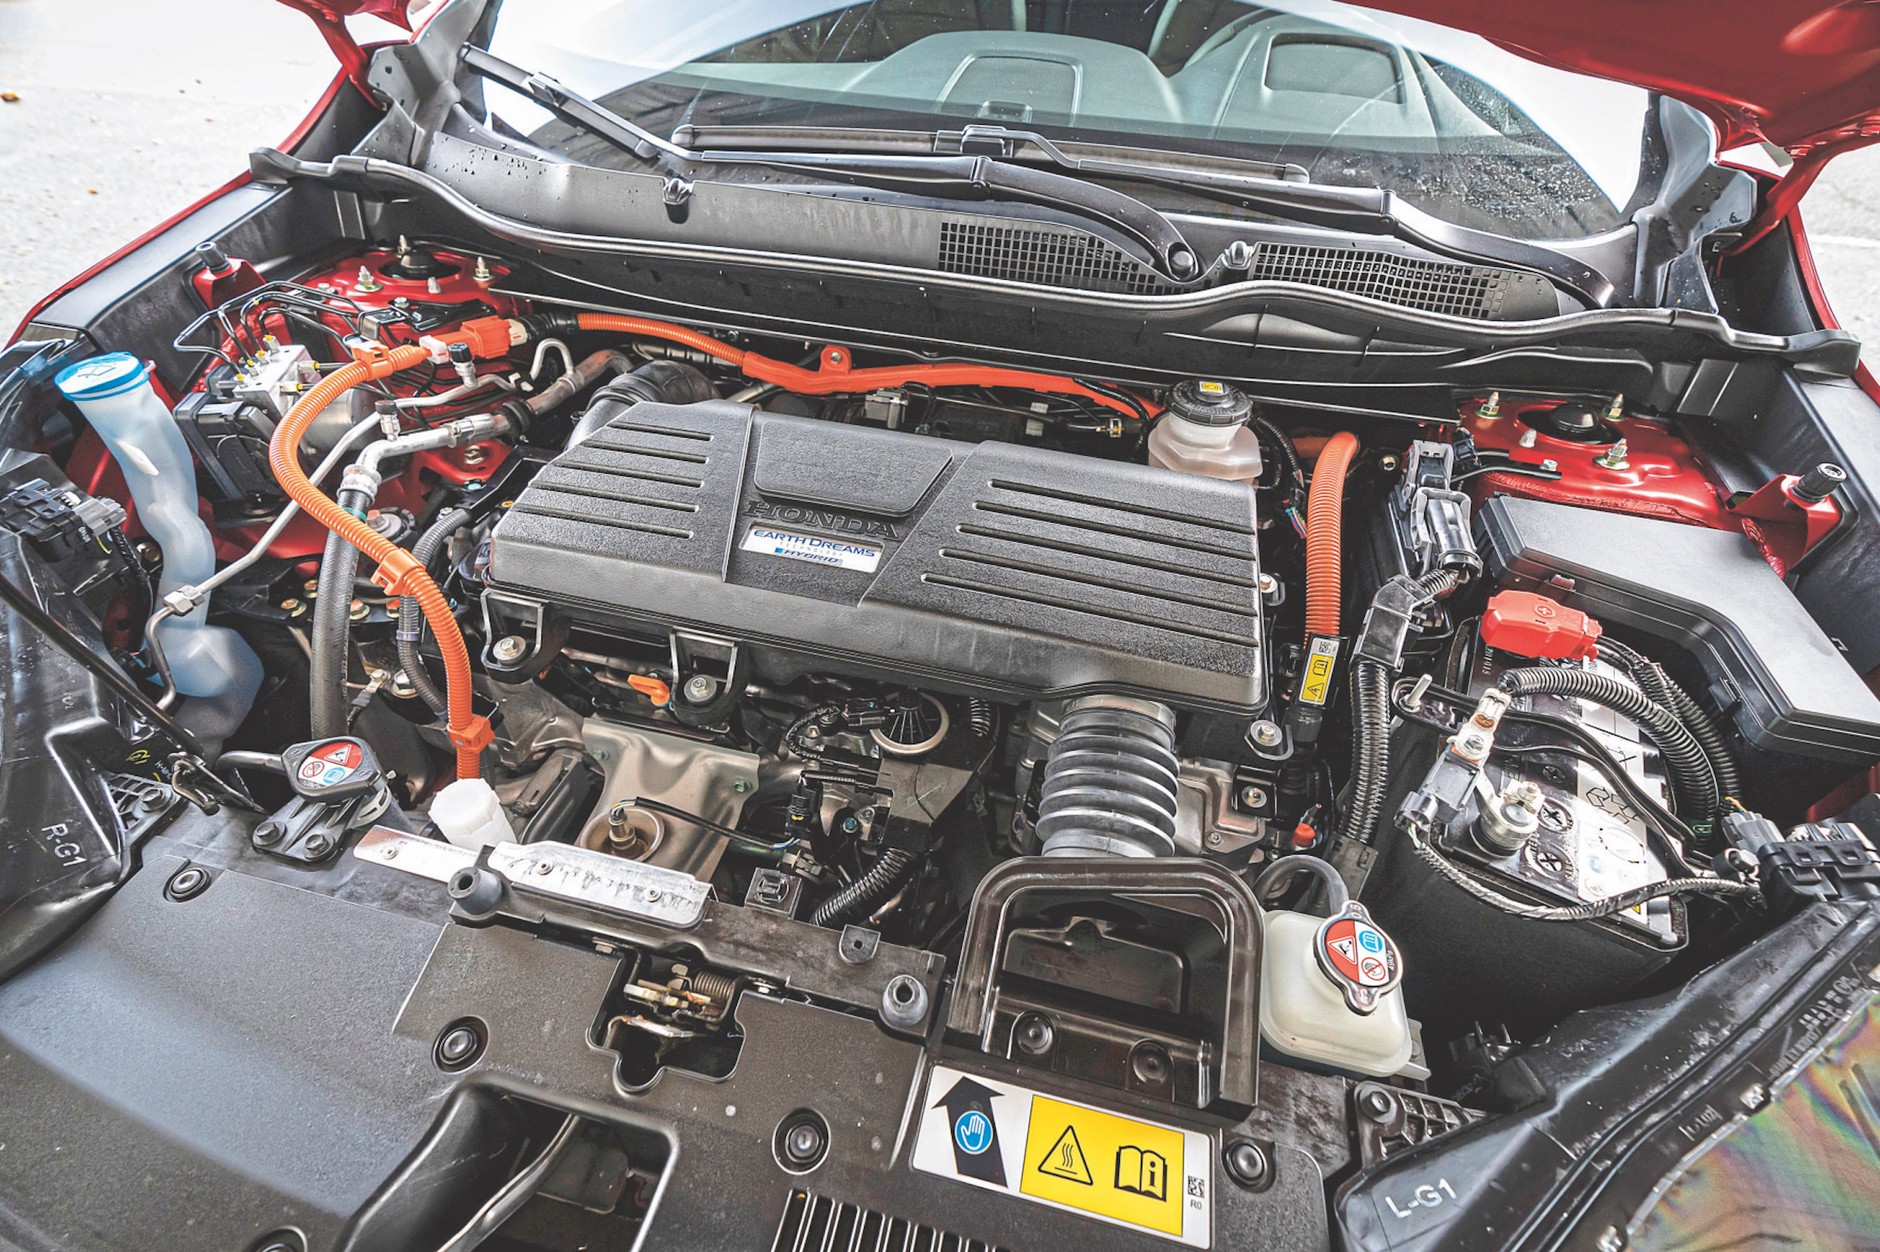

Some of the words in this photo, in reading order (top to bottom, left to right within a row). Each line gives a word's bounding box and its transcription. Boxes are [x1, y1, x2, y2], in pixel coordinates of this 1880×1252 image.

[743, 502, 899, 541] HONDA
[754, 529, 806, 545] EARTH
[809, 538, 876, 558] DREAMS
[784, 549, 838, 563] HYBRID
[41, 823, 87, 867] R-G1
[1384, 1177, 1457, 1218] L-G1
